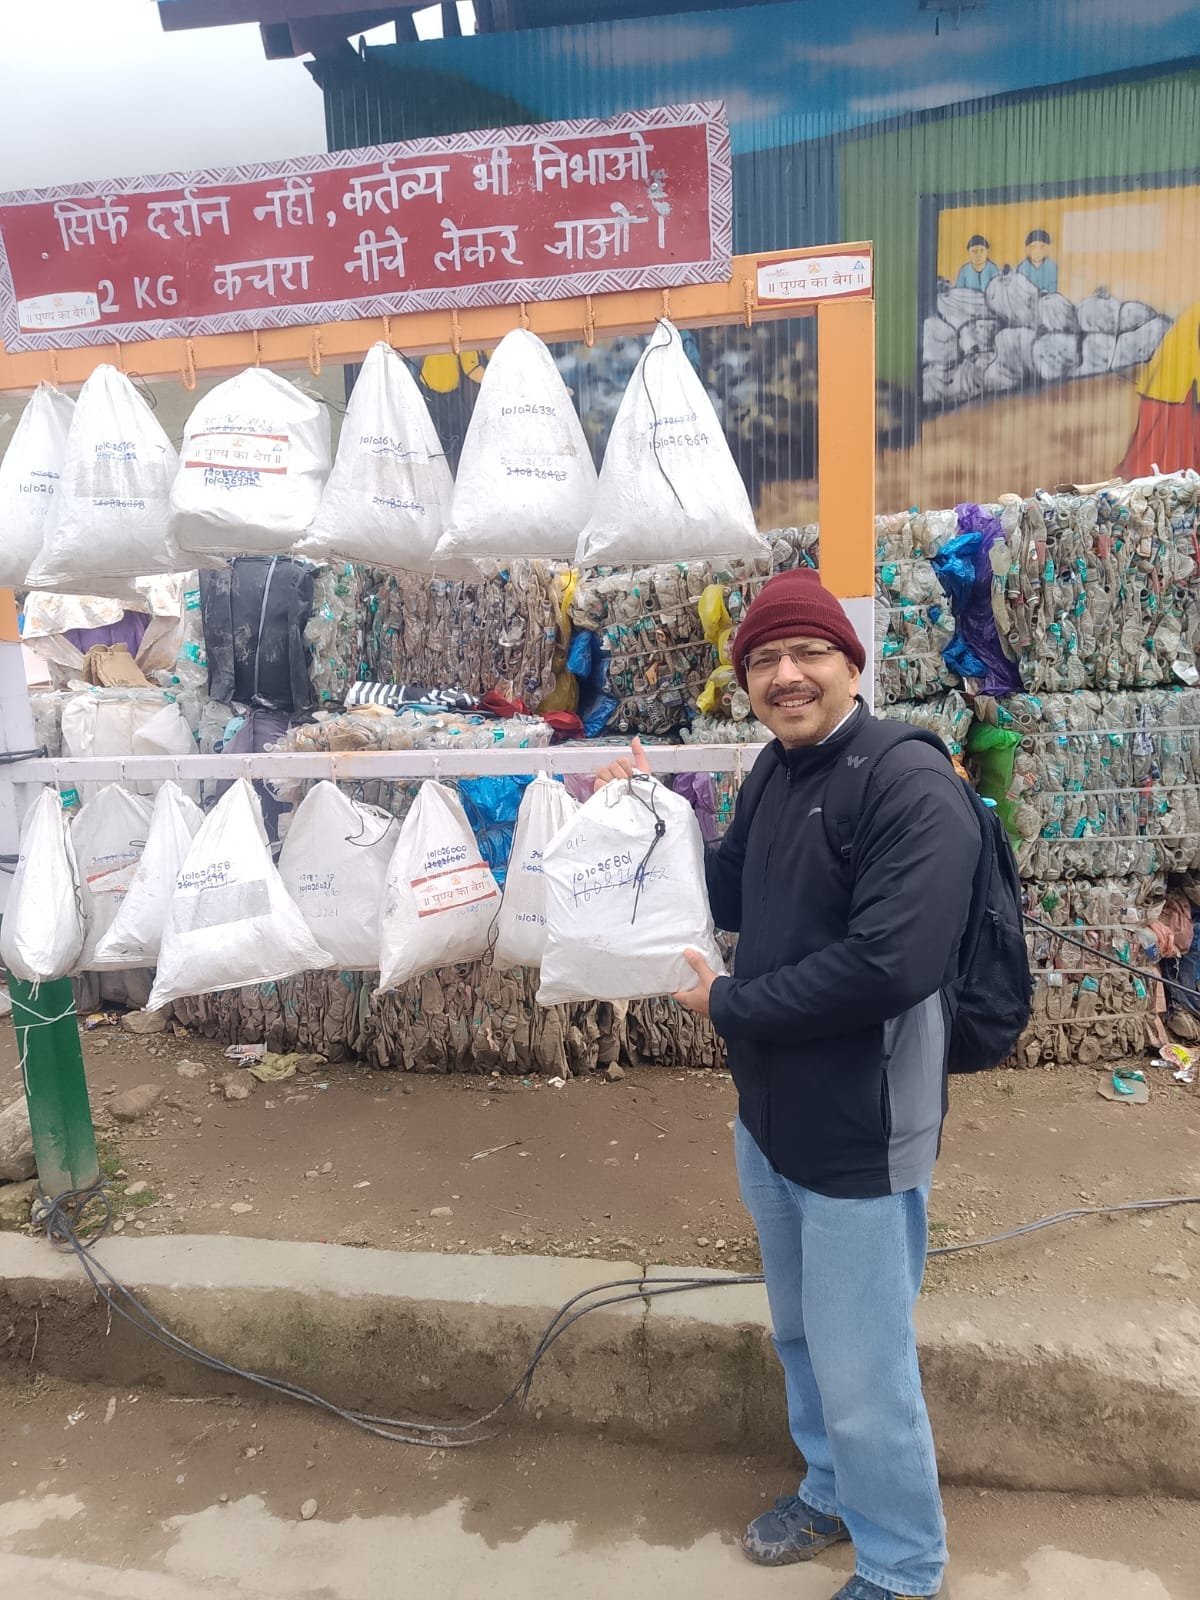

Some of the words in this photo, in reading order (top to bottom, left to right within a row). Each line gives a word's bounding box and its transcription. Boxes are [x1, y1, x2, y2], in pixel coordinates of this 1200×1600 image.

[54, 195, 130, 251] सिर्फ
[147, 188, 231, 239] दर्शन
[473, 146, 512, 195] भी
[533, 133, 653, 191] निभाओ
[98, 279, 120, 314] 2
[133, 275, 178, 309] KG
[214, 255, 314, 301] कचरा
[345, 228, 408, 282] नीचे
[434, 218, 524, 272] लेकर
[544, 201, 649, 260] जाओ
[779, 279, 806, 295] पुण्य
[811, 276, 828, 288] का
[832, 271, 853, 286] बैग
[57, 309, 71, 320] का
[455, 885, 470, 898] का
